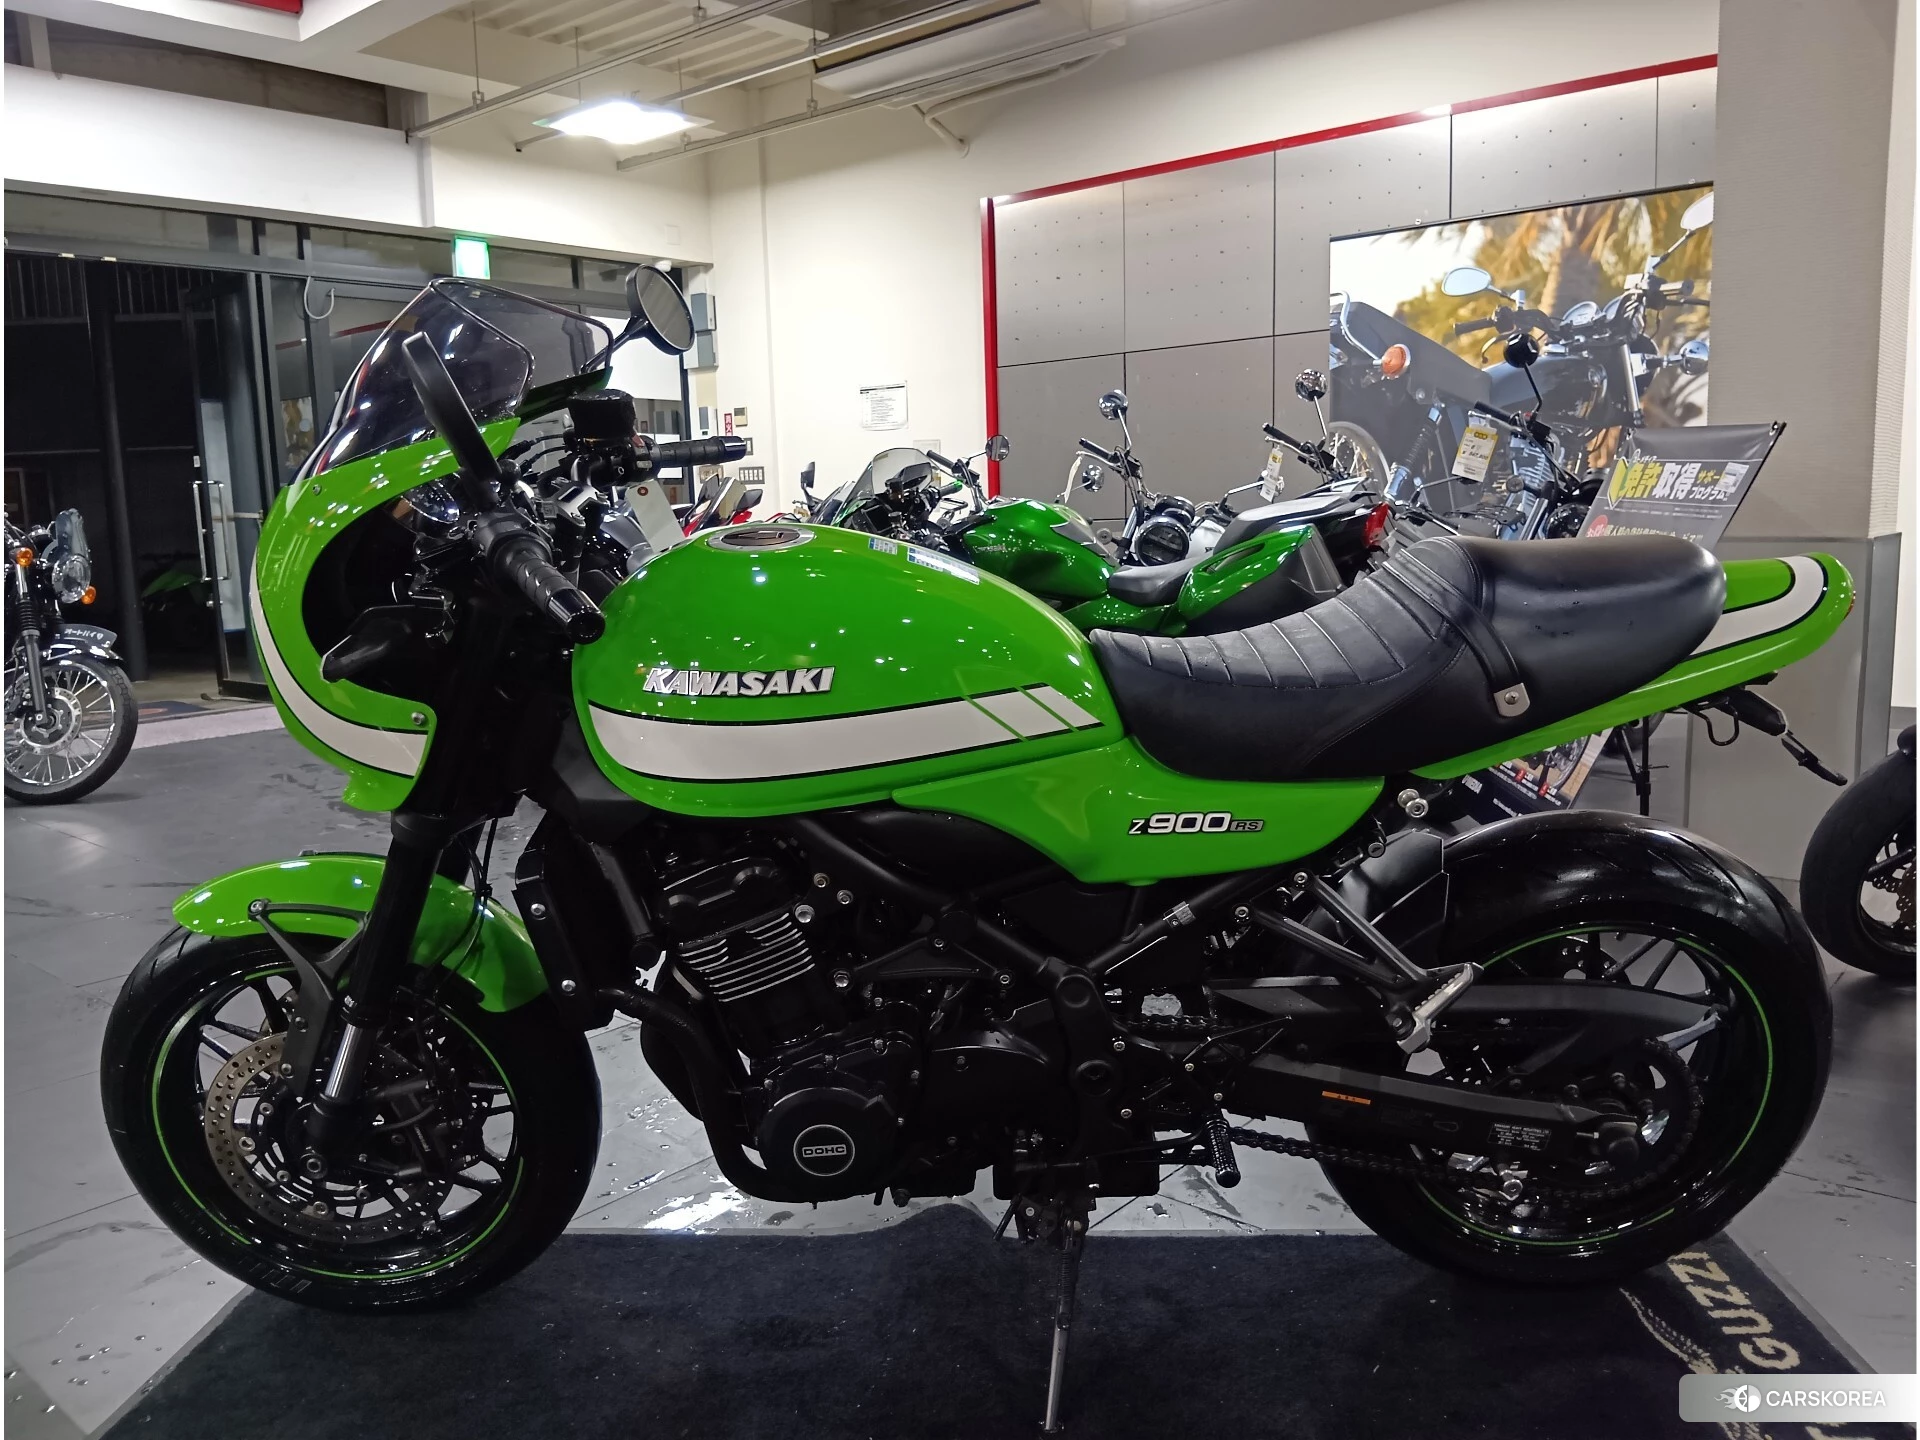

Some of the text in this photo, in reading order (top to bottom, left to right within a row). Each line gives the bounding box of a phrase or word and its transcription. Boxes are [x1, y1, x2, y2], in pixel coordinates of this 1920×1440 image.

[1697, 470, 1720, 484] サポー
[643, 667, 835, 697] KAWASAKI
[803, 1146, 846, 1156] DOHC
